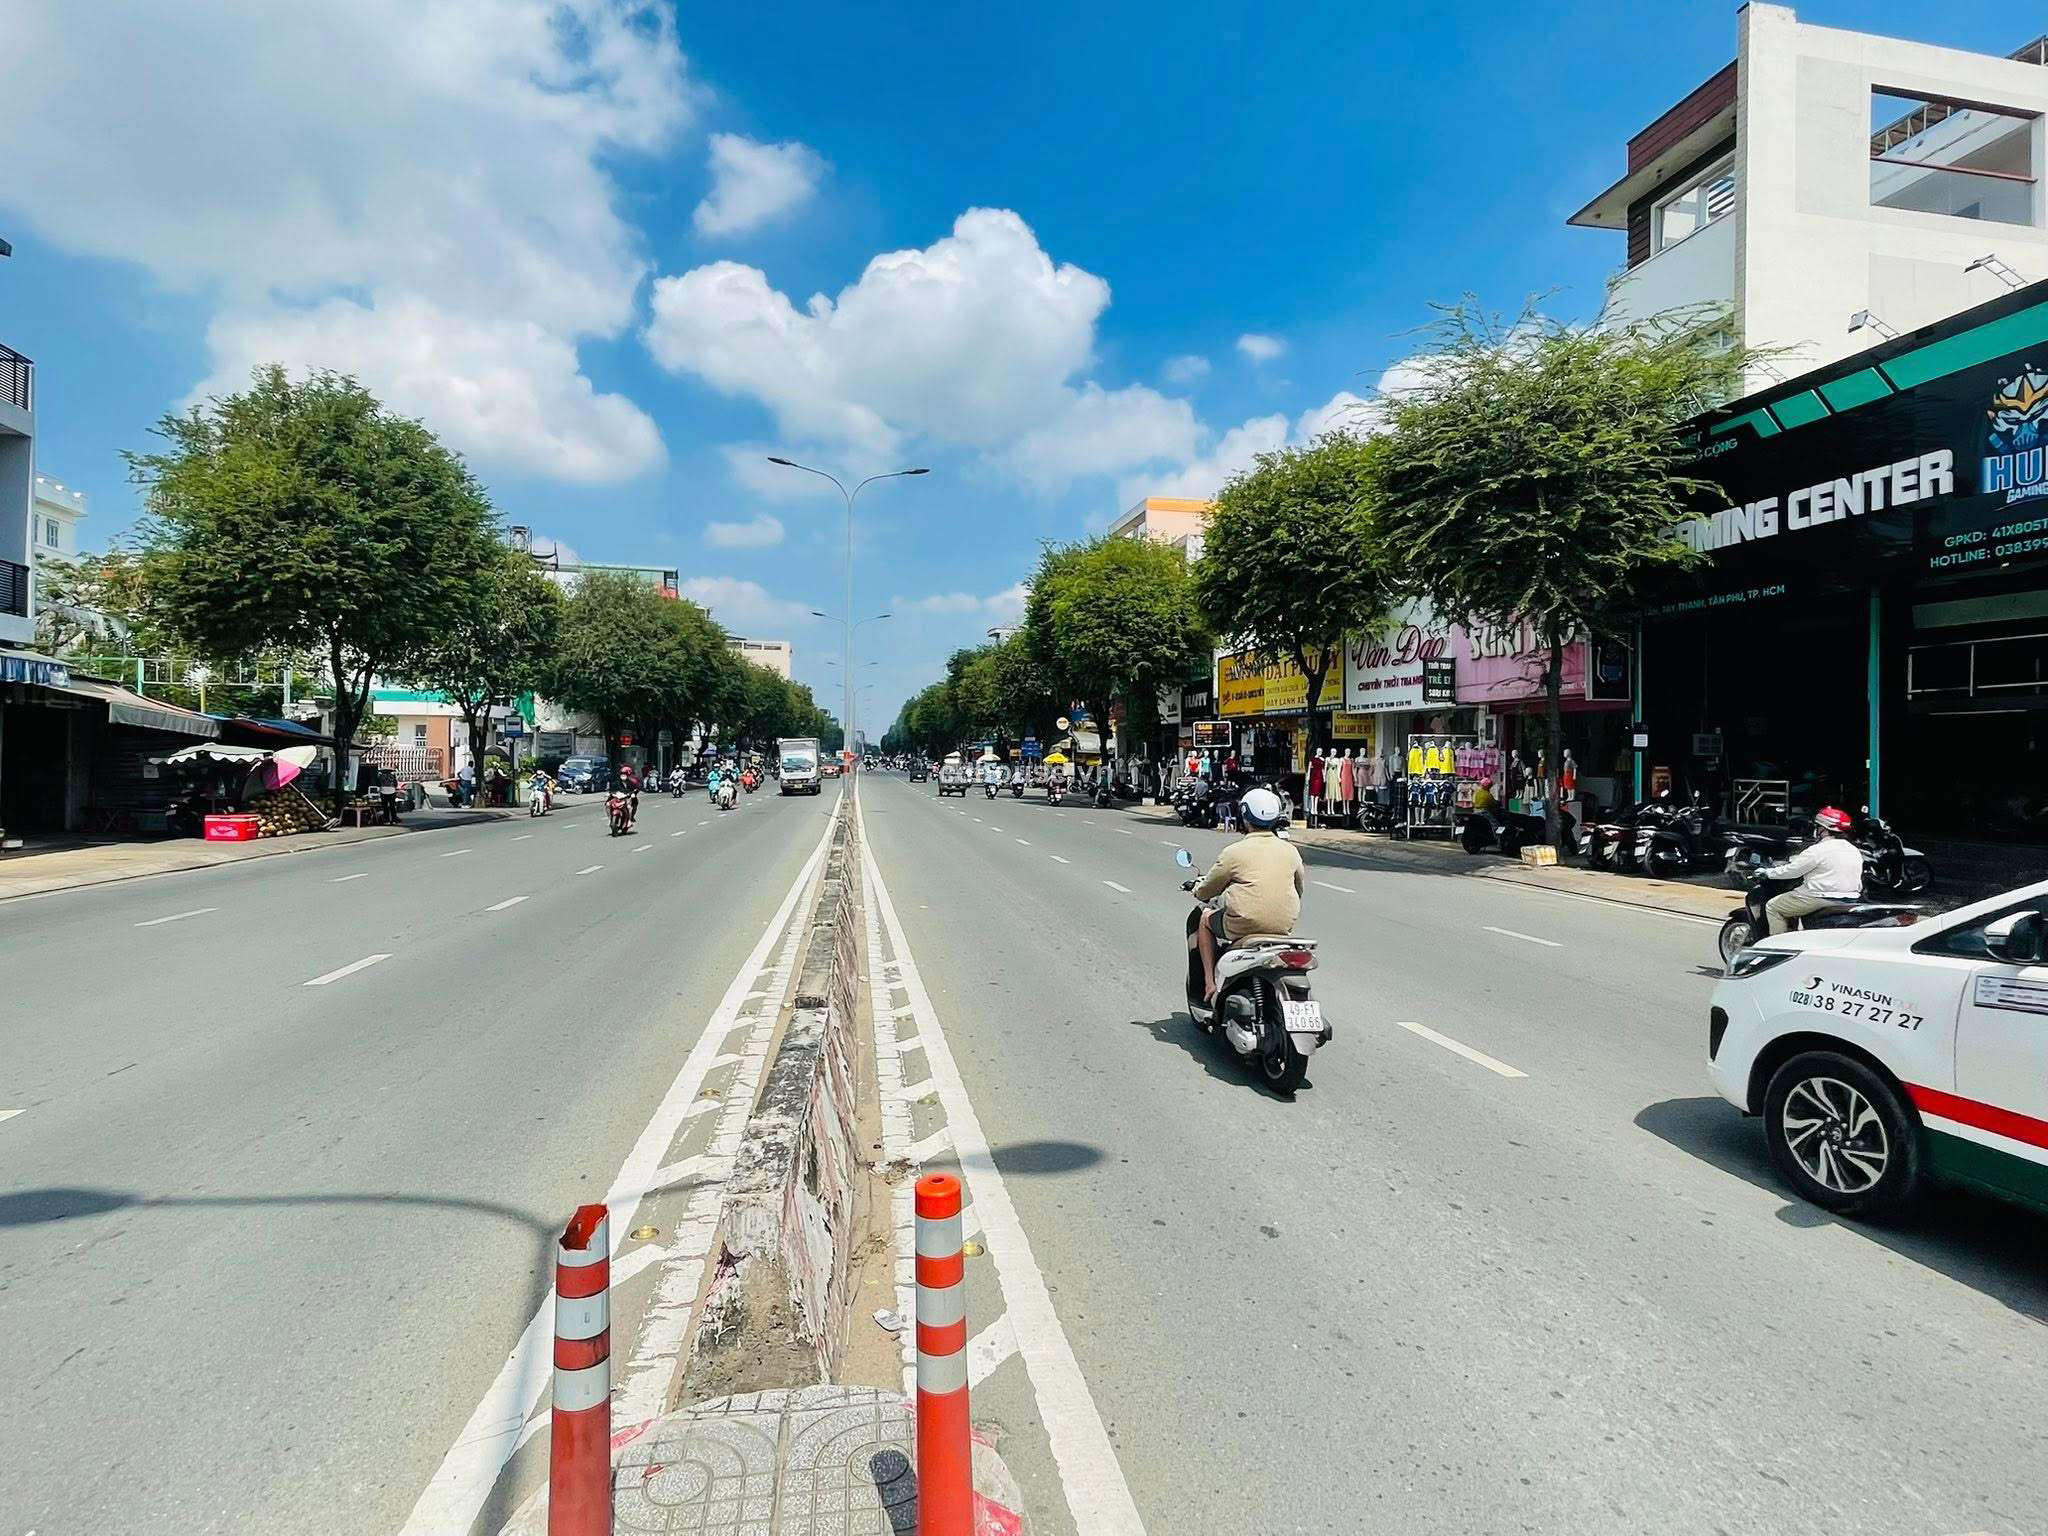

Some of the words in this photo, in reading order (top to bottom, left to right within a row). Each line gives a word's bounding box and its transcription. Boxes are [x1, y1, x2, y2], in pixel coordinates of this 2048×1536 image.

[1983, 445, 2048, 494] HU
[1787, 448, 1954, 531] CENTER
[1944, 531, 1987, 547] GPKD:
[1930, 549, 1991, 568] HOTLINE:
[1762, 584, 1785, 597] HCM
[1831, 982, 1893, 1006] VINASUN
[1789, 990, 1814, 1006] (028)
[1814, 995, 1835, 1011] 38
[1841, 1000, 1866, 1017] 27
[1868, 1007, 1893, 1024] 27
[1898, 1013, 1924, 1031] 27
